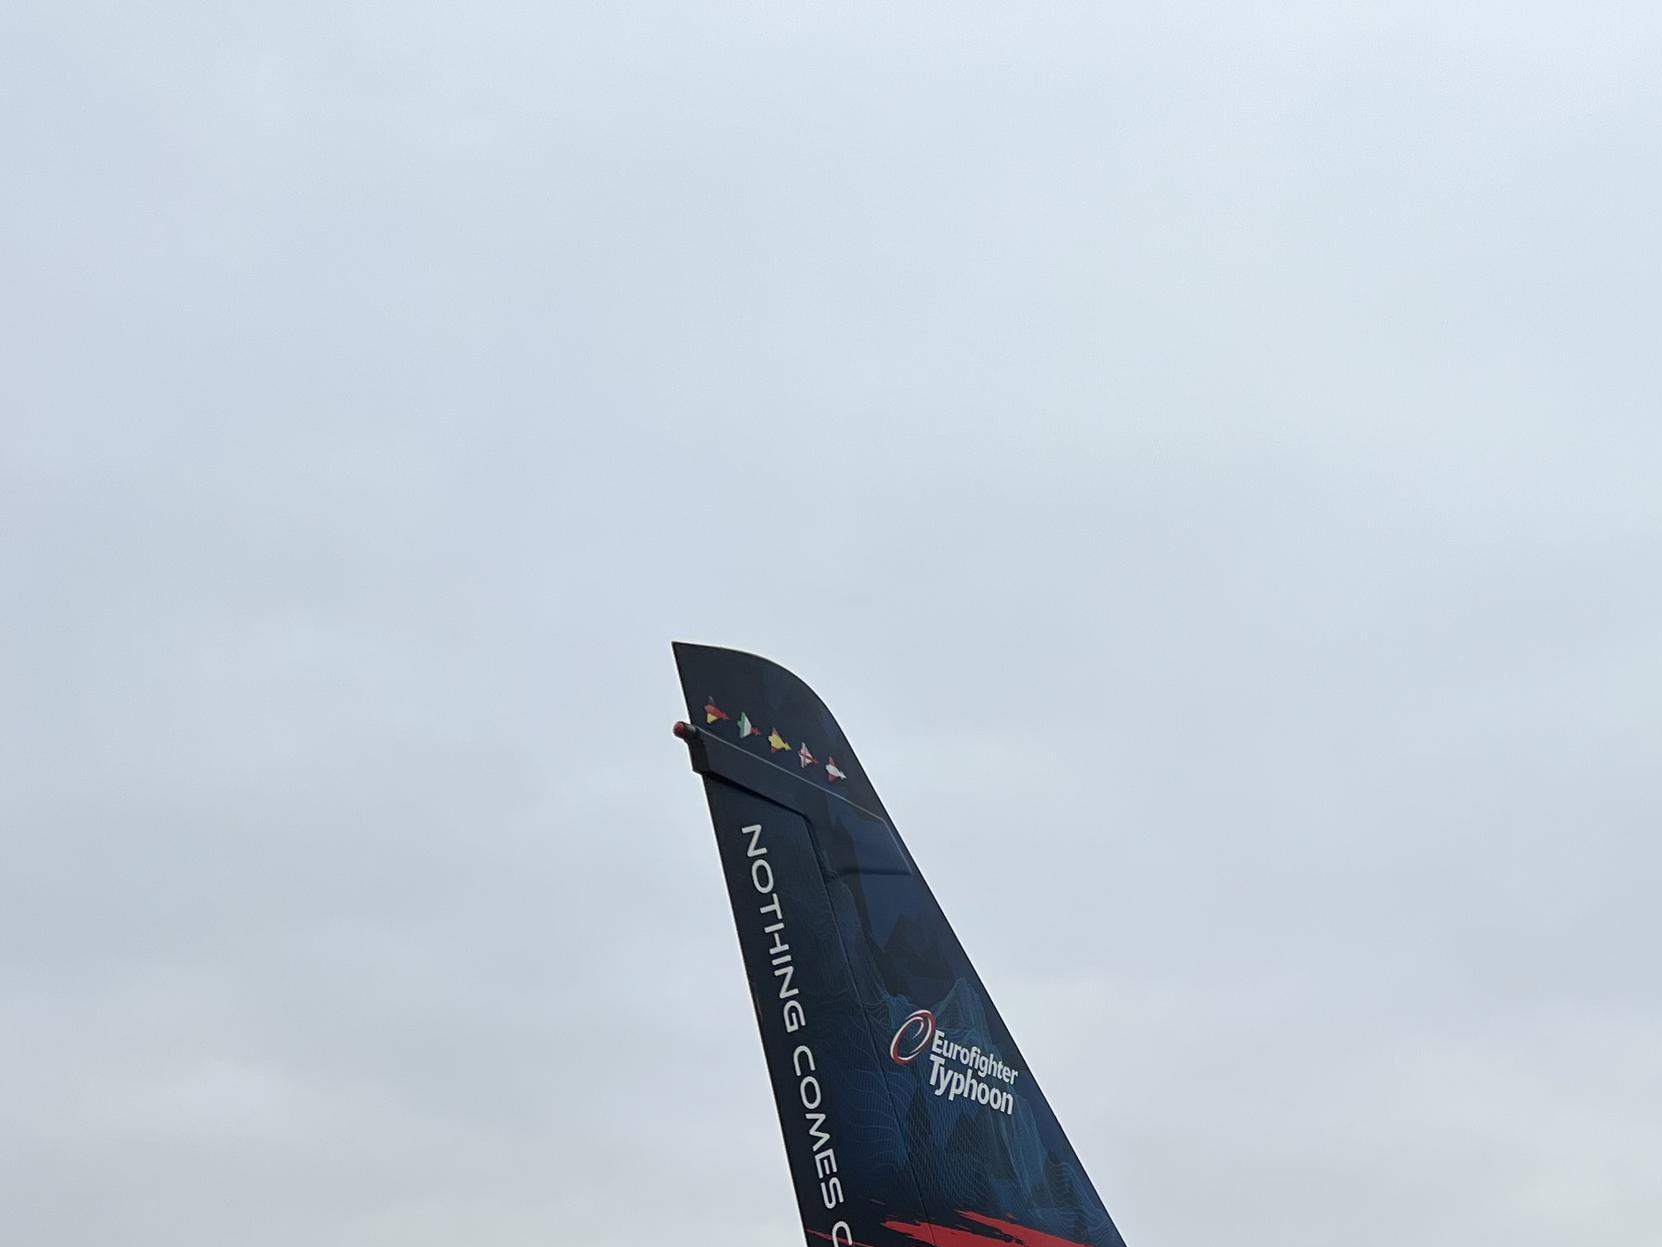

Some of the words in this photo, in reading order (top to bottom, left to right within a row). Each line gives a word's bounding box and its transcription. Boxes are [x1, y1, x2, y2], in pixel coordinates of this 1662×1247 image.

[741, 824, 807, 1033] NOTHING
[793, 1045, 844, 1209] COMES
[929, 1054, 1014, 1115] Typhoon
[931, 1029, 1018, 1085] Eurofighter
